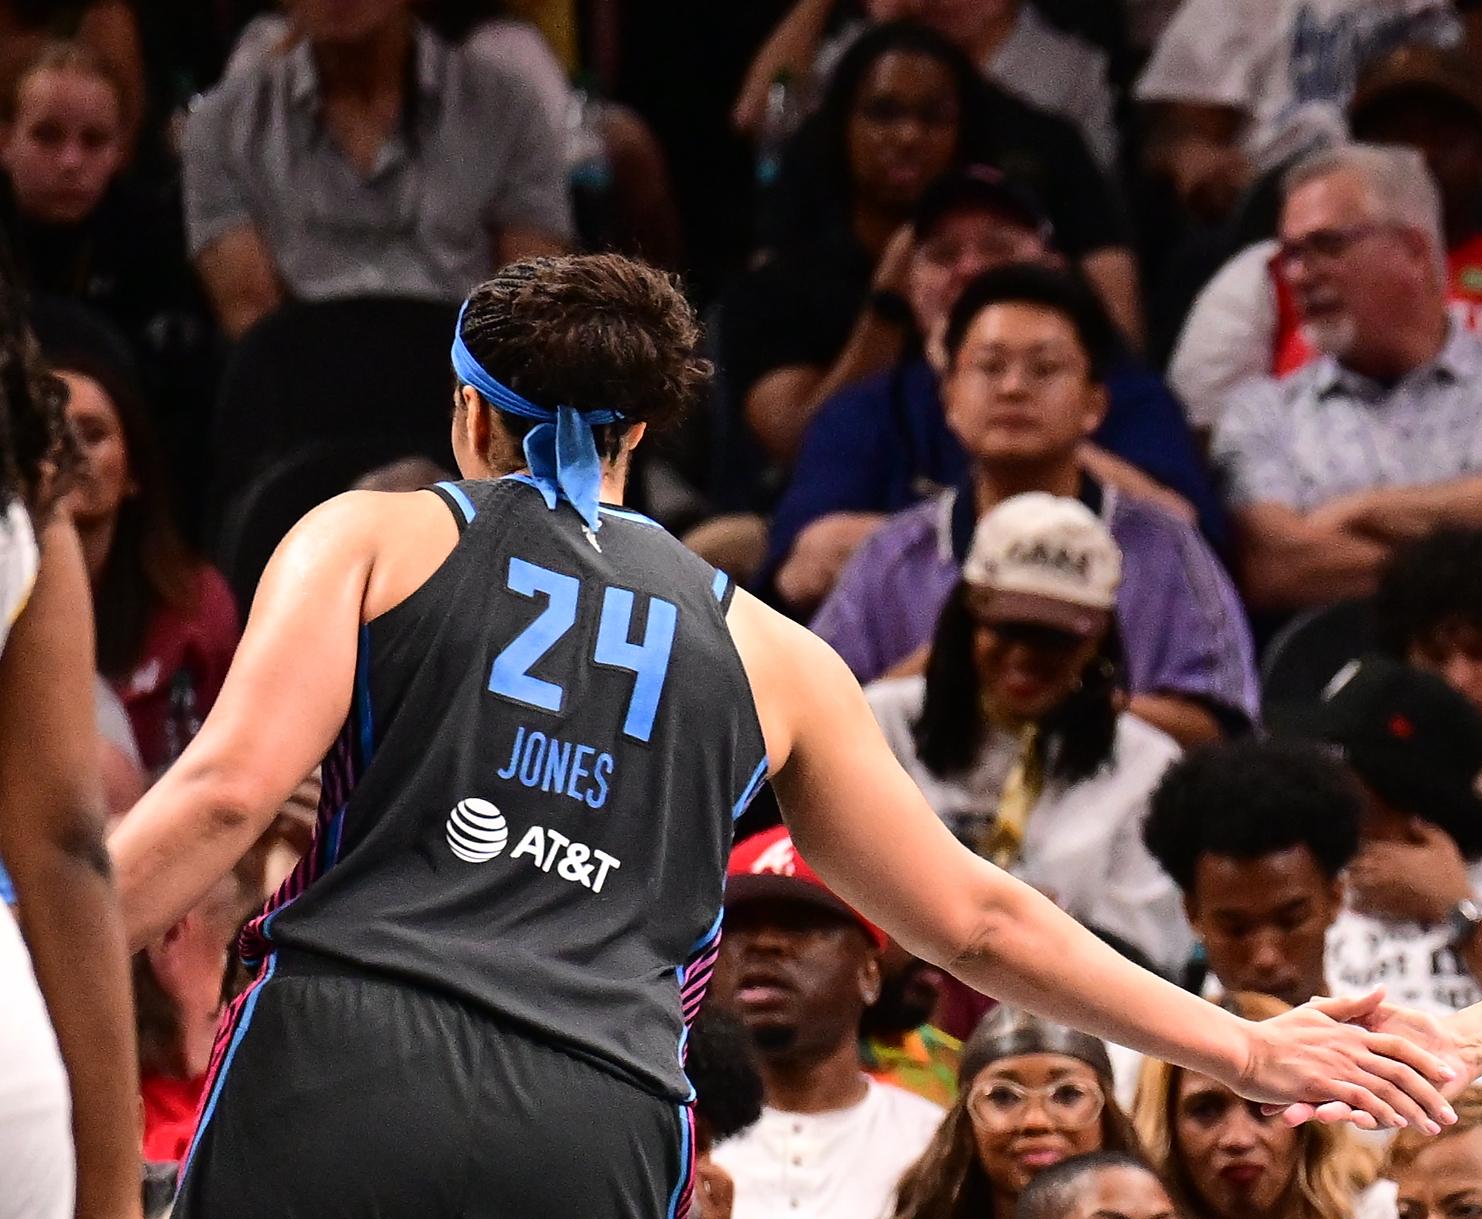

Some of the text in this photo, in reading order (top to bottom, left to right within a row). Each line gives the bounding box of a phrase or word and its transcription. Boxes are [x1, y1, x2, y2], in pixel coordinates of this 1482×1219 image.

[488, 557, 678, 742] 24
[497, 726, 614, 809] JONES
[510, 826, 621, 894] AT&T
